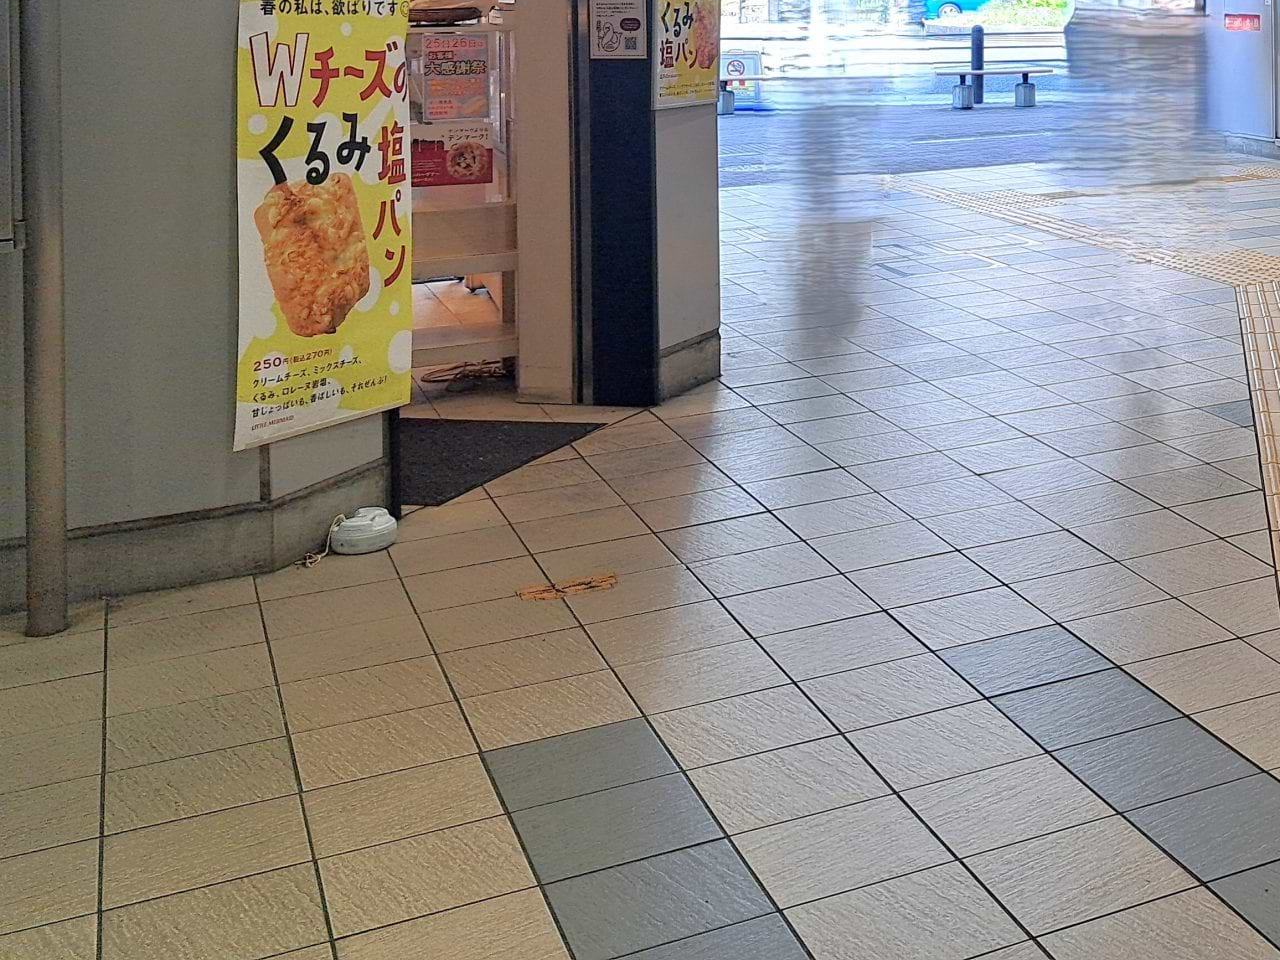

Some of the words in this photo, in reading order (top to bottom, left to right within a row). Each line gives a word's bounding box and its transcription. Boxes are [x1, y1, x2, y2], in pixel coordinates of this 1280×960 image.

[661, 1, 694, 38] くるみ
[660, 38, 699, 70] 塩パン
[259, 112, 371, 186] くるみ
[373, 120, 407, 288] 塩パン
